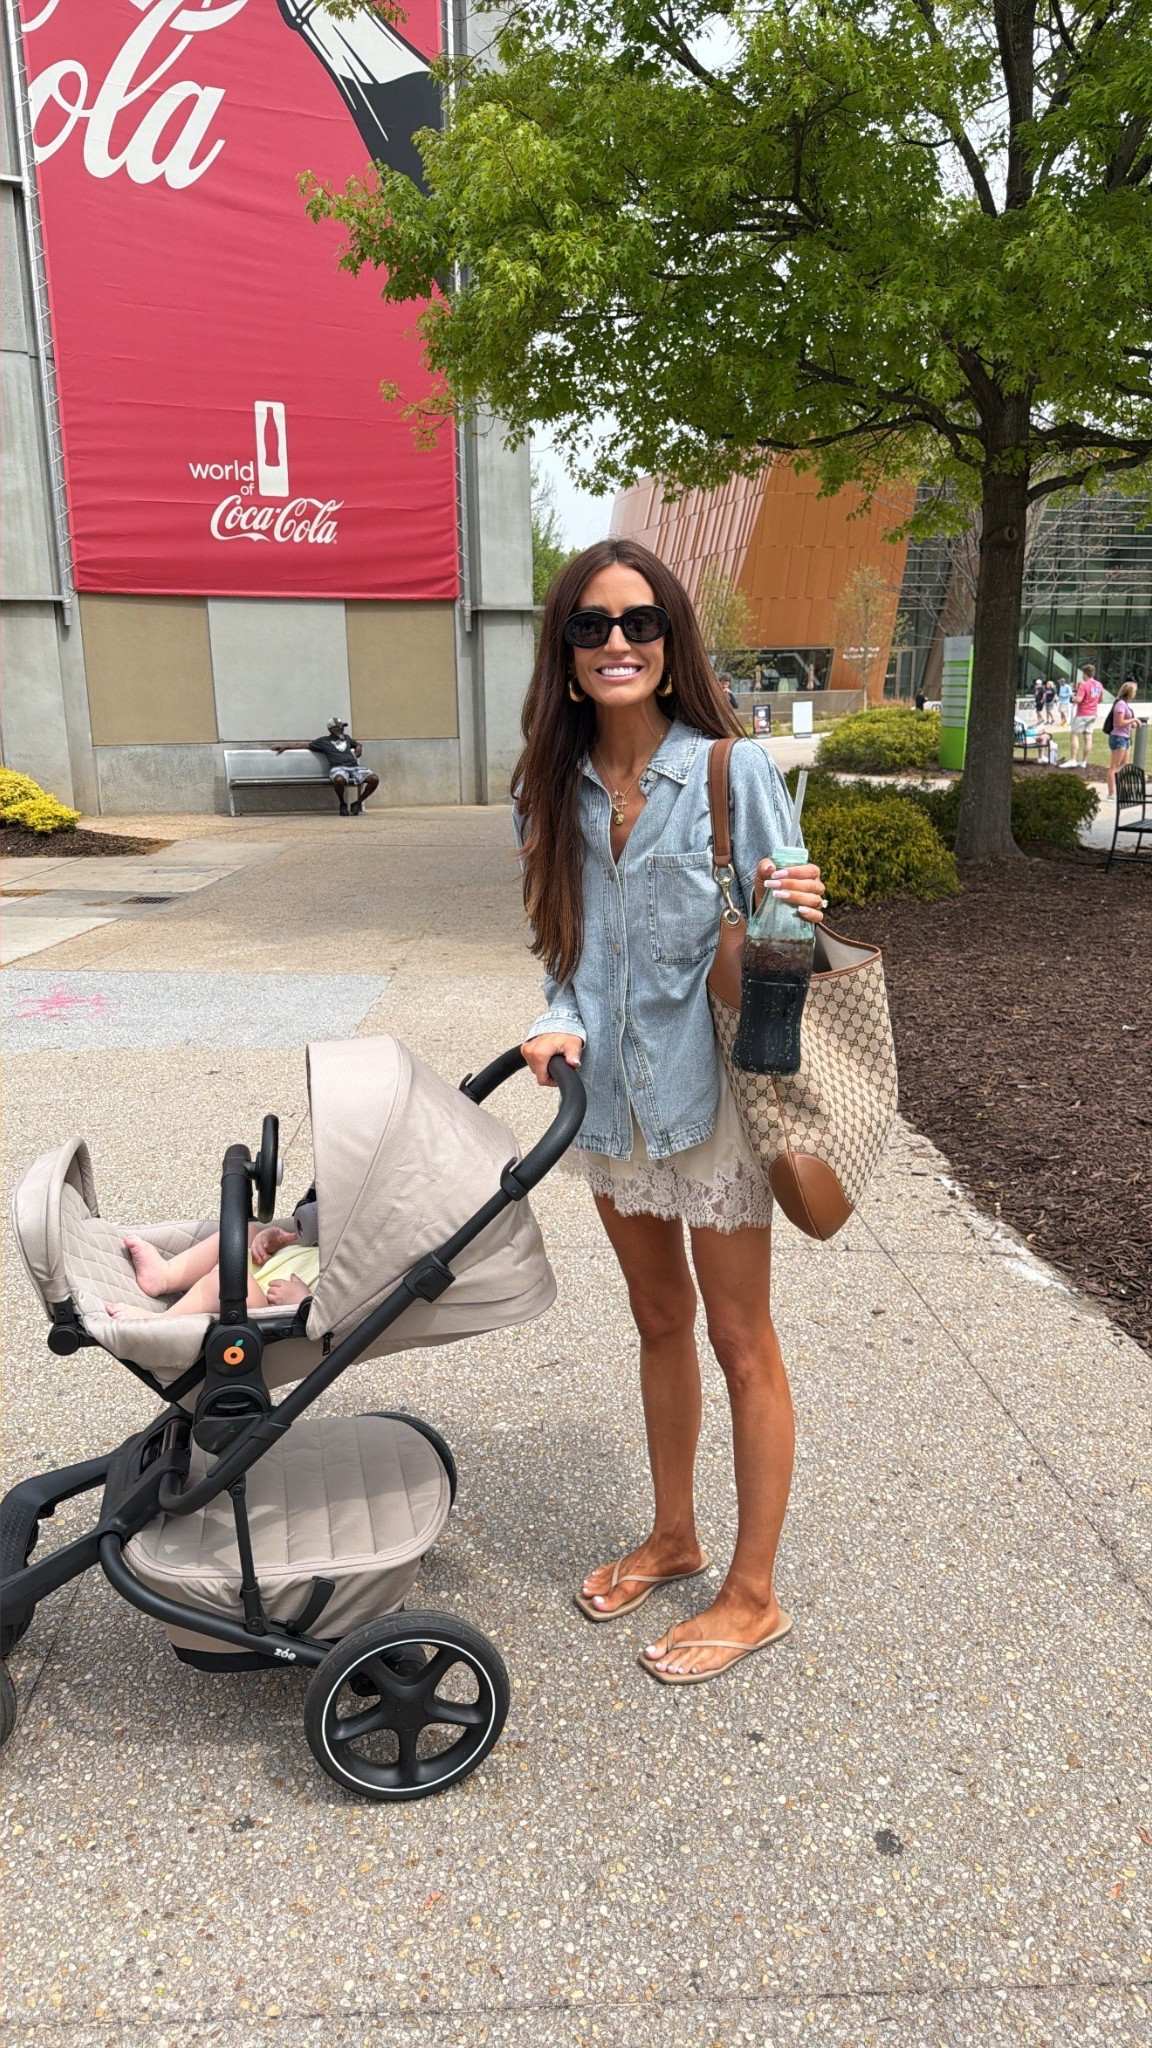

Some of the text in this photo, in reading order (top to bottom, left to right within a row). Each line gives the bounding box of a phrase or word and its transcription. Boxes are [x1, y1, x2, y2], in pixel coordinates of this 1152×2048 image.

[27, 0, 226, 190] ola
[188, 459, 255, 482] world
[240, 483, 255, 496] of
[210, 494, 345, 544] Coca-Cola
